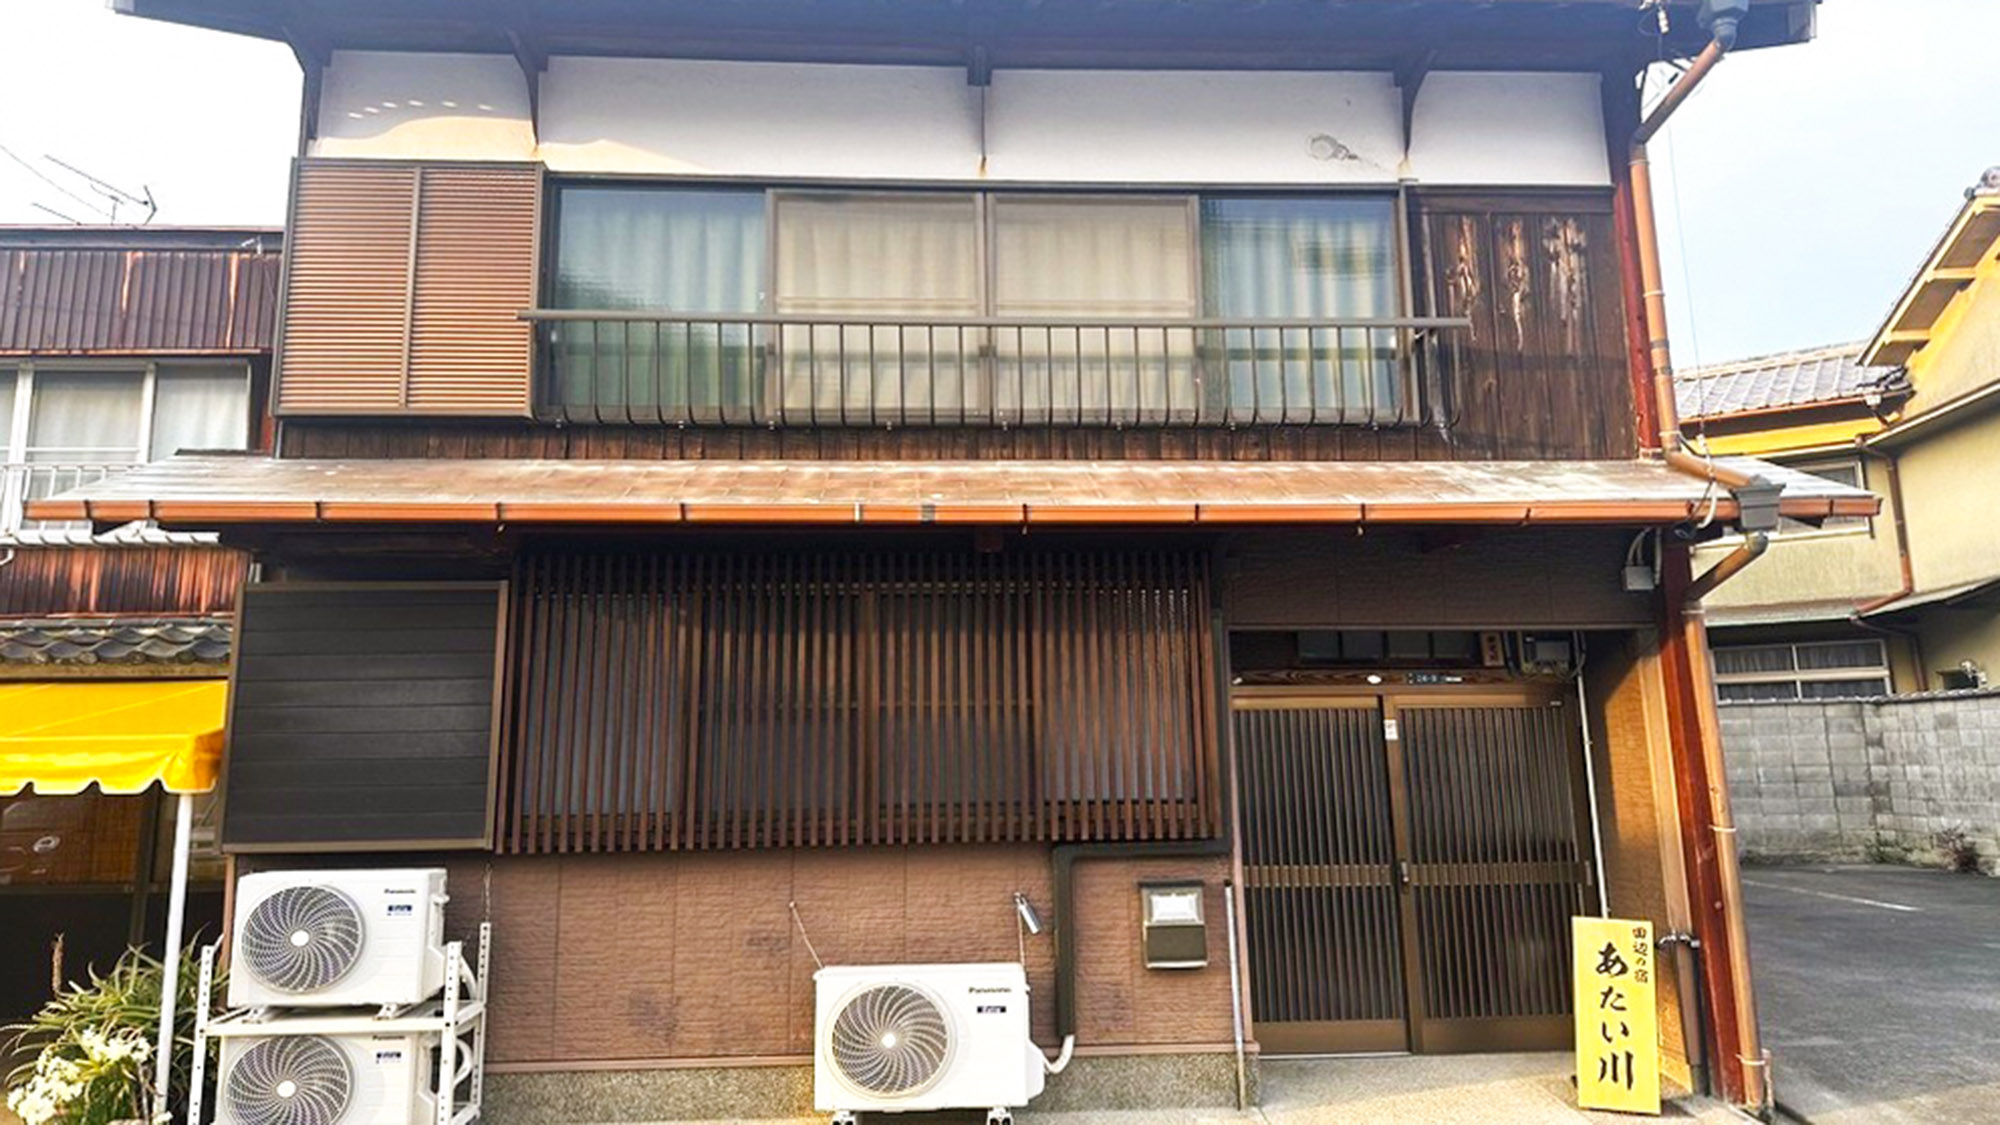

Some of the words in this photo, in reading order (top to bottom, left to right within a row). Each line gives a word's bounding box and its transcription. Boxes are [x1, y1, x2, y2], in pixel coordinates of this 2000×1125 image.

[1632, 926, 1649, 984] 田辺の宿
[968, 986, 1011, 994] Panasonic
[1595, 941, 1634, 1091] あたい川
